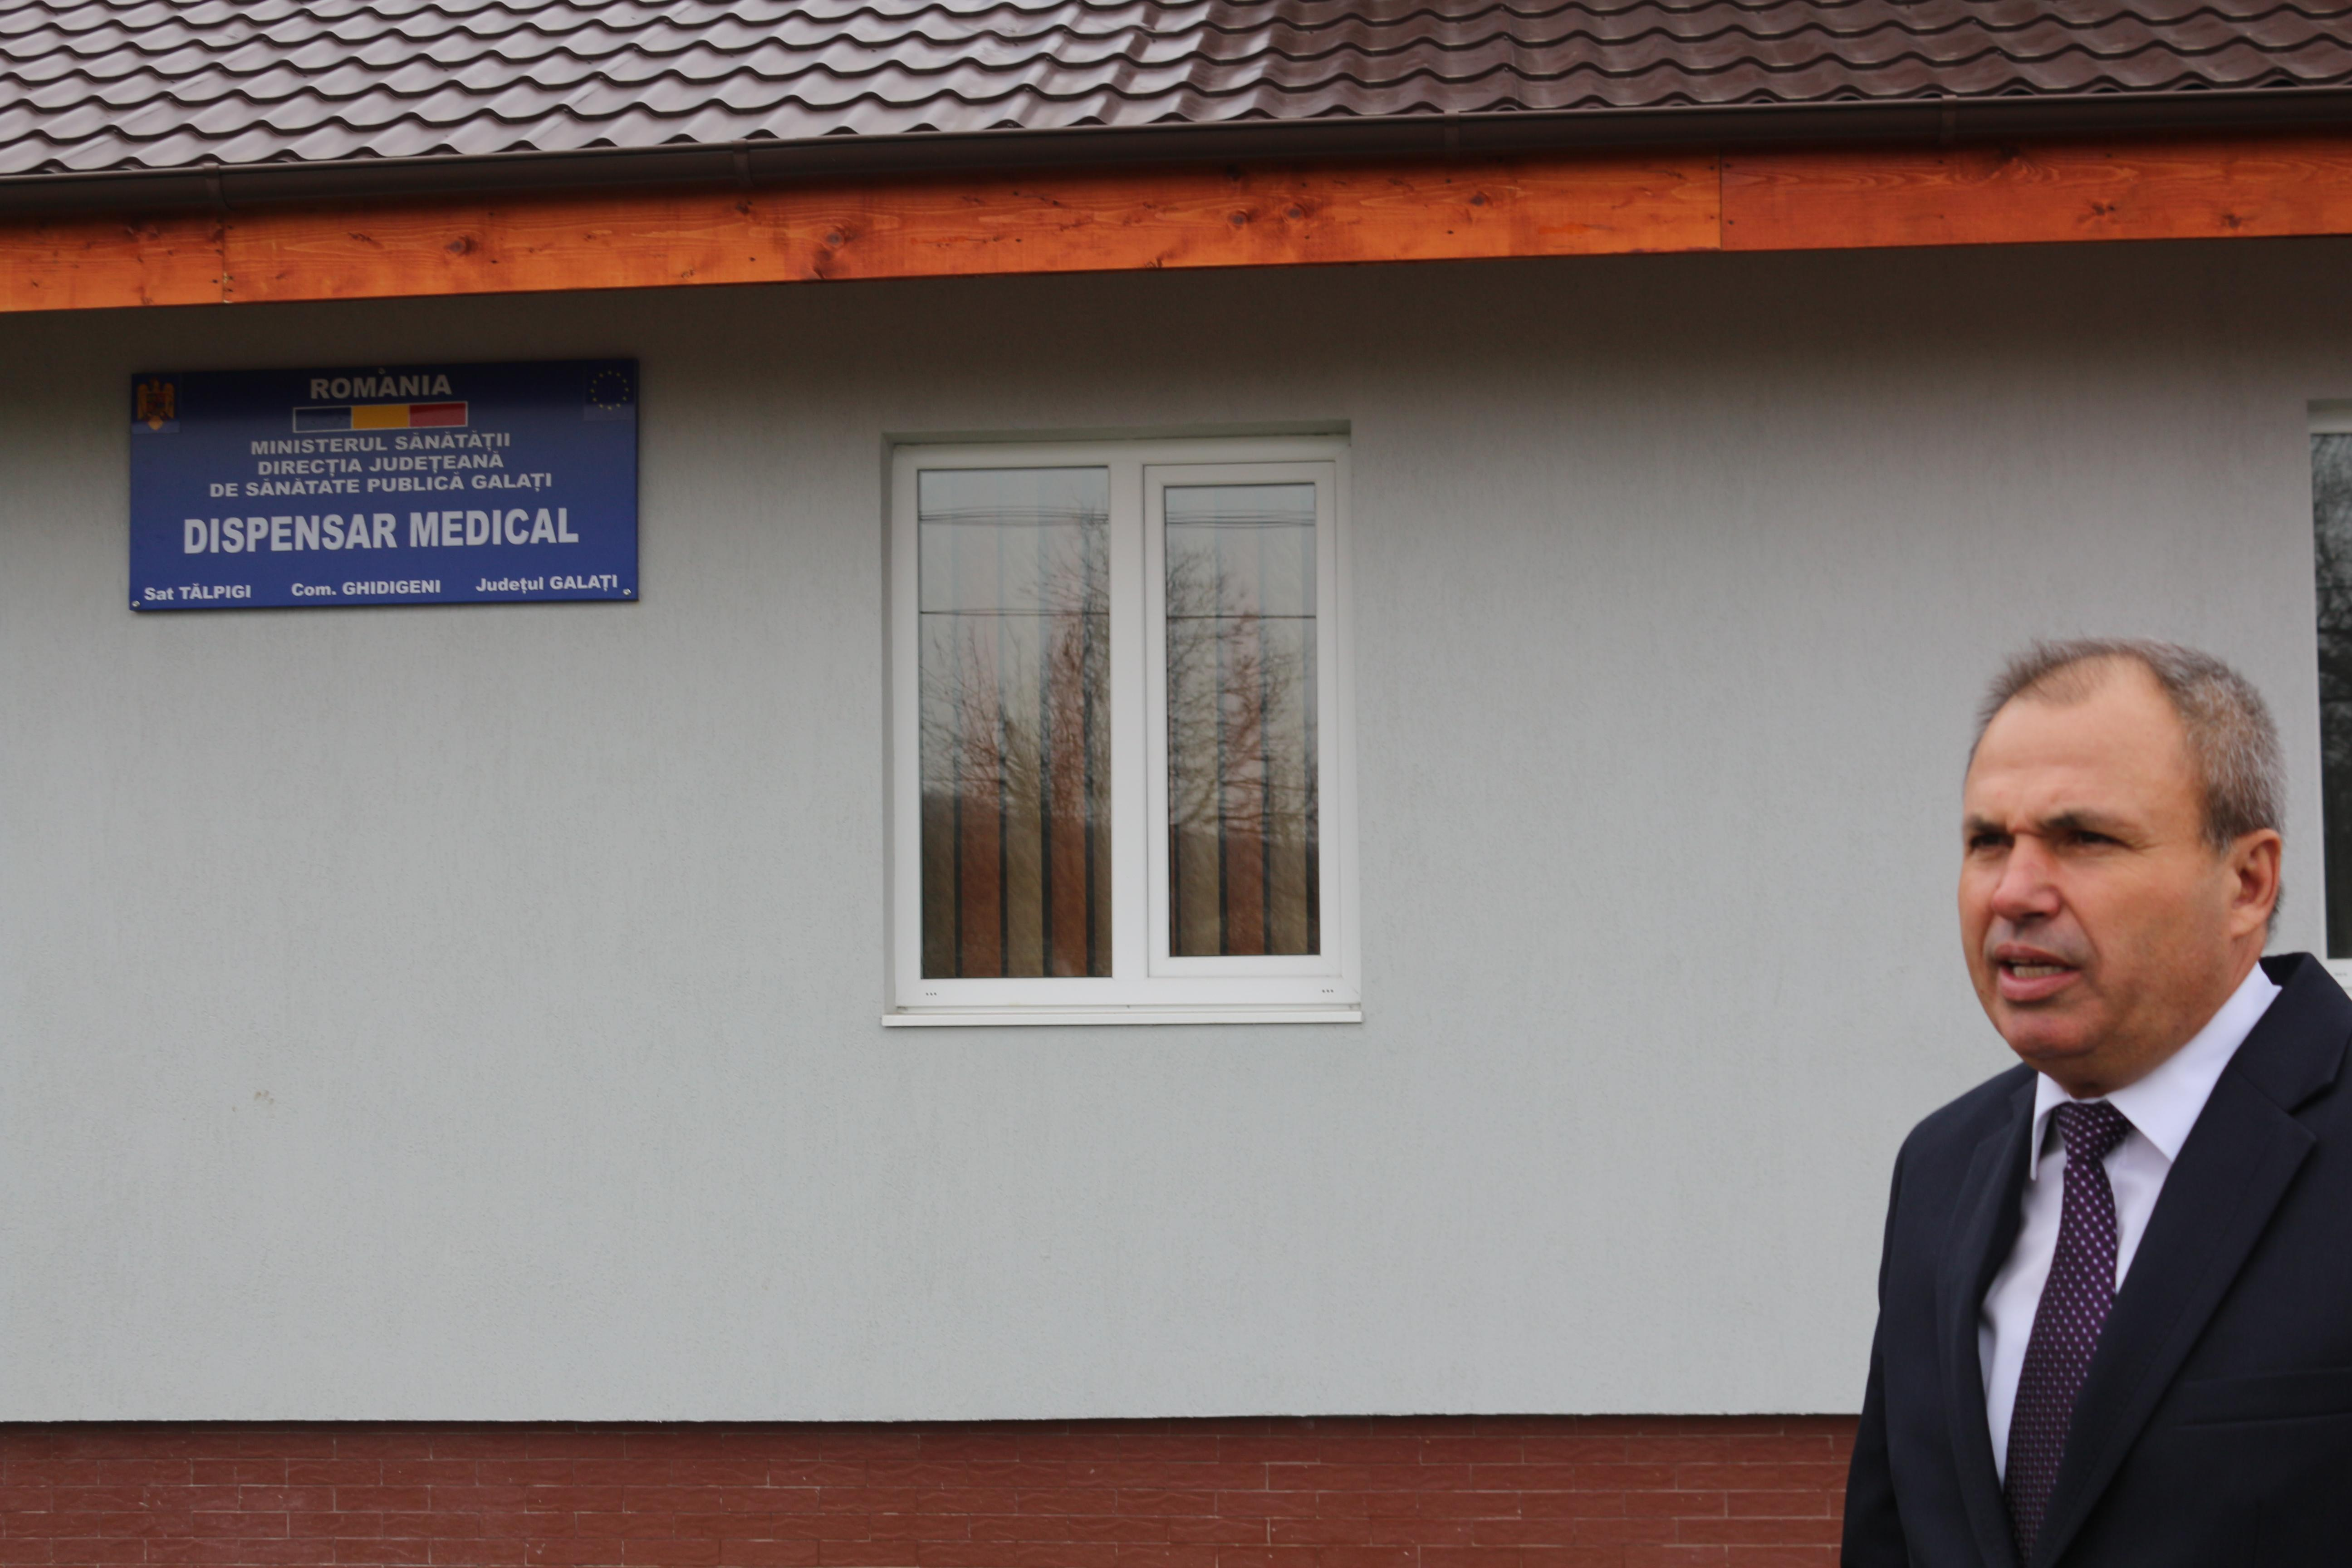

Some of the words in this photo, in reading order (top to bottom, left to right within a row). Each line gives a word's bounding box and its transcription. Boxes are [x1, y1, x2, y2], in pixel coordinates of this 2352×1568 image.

[251, 437, 387, 455] MINISTERUL
[210, 483, 239, 497] DE
[245, 478, 360, 496] SĂNĂTATE
[367, 472, 465, 493] PUBLICĂ
[183, 513, 397, 554] DISPENSAR
[410, 508, 579, 548] MEDICAL
[144, 587, 174, 601] Sat
[179, 583, 251, 599] TĂLPIGI
[291, 583, 337, 597] Com.
[342, 580, 441, 595] GHIDIGENI
